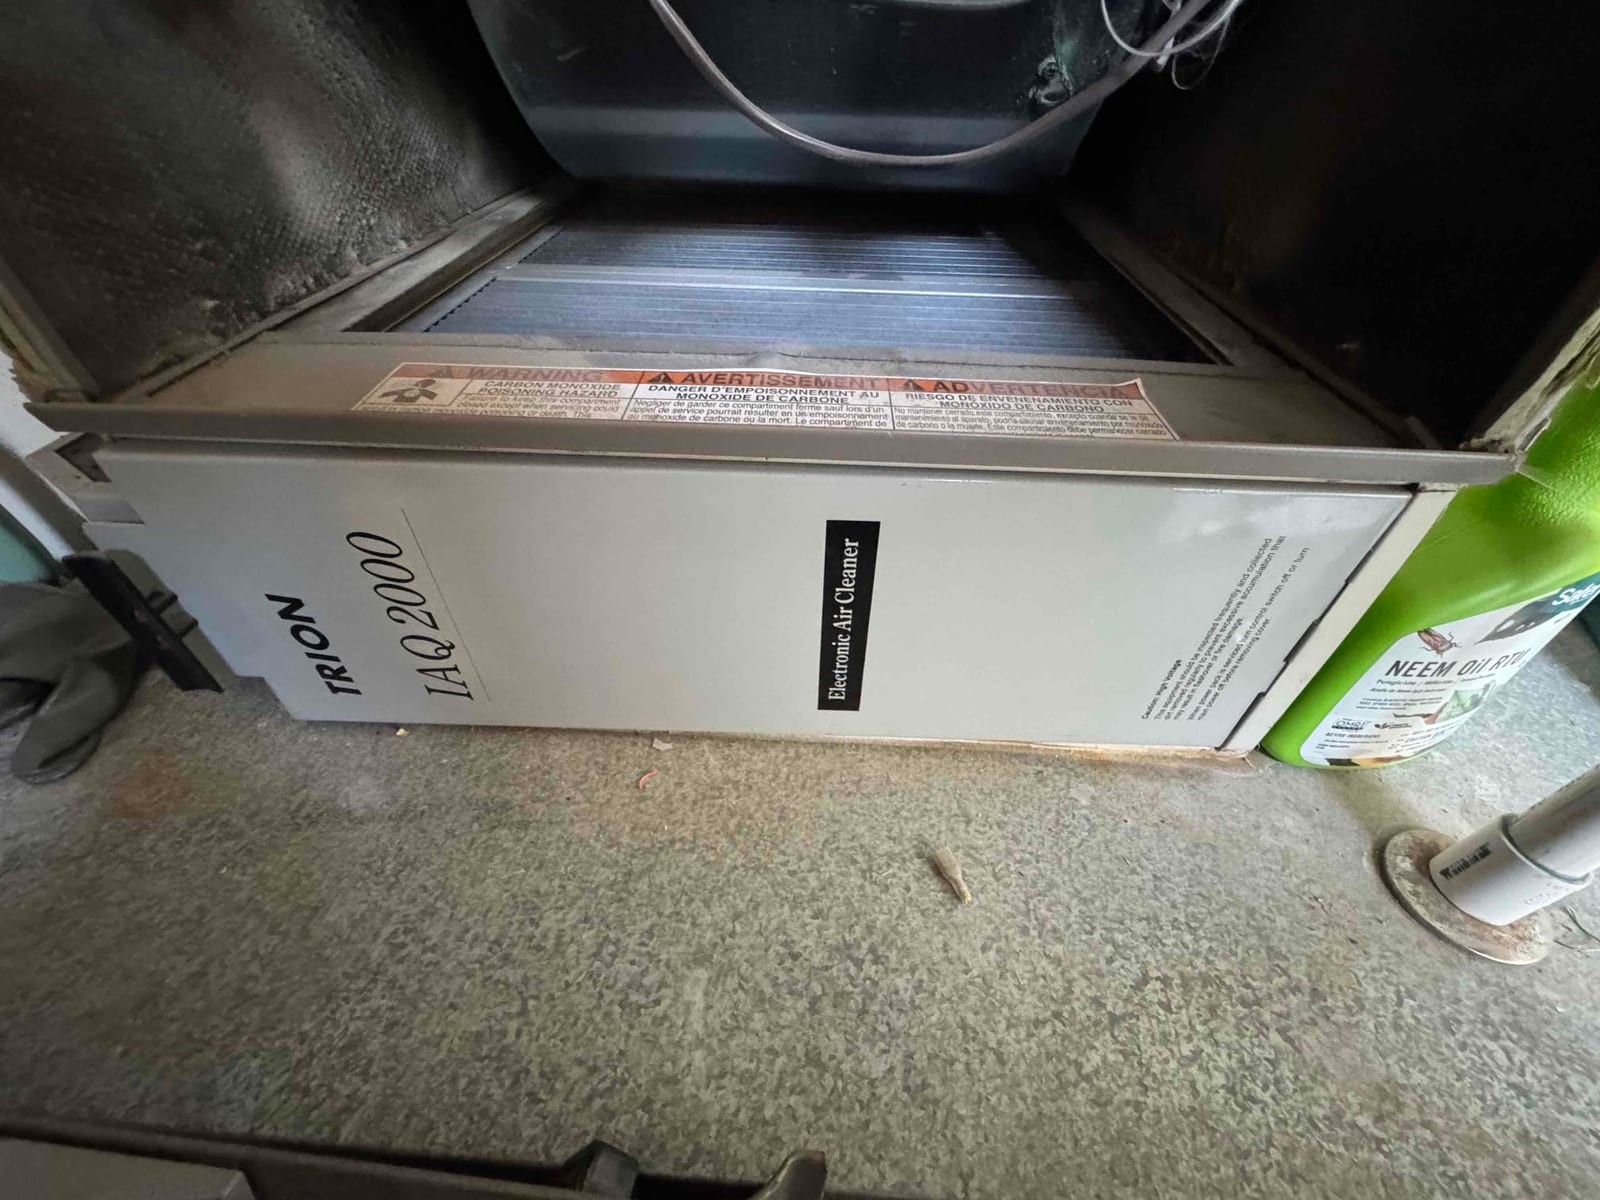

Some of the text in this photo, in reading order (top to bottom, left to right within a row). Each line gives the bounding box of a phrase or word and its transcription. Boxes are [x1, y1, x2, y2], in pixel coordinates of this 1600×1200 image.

[471, 368, 603, 382] WARNING
[681, 372, 879, 389] AVERTISSEMENT
[478, 387, 619, 398] POISONING HAZARD
[485, 381, 621, 391] CARBON MONOXIDE
[648, 385, 707, 393] DANGER
[711, 386, 855, 397] D'EMPOISONNEMENT
[933, 380, 1128, 398] ADVERTENCIA
[559, 397, 620, 406] compartment
[676, 392, 850, 404] MONOXIDE DE CARBONE
[905, 393, 955, 401] RIESGO
[979, 395, 1101, 405] ENVENENAMIENTO
[687, 401, 717, 409] garder
[732, 402, 793, 410] compartiment
[824, 404, 843, 412] sauf
[1015, 402, 1034, 410] DE
[1037, 404, 1105, 413] CARBONO
[706, 408, 742, 416] pourrait
[809, 411, 888, 420] empoisonnement
[703, 415, 741, 423] carbone
[809, 418, 873, 427] compartiment
[875, 420, 888, 428] de
[1196, 622, 1219, 652] inspected
[1214, 589, 1241, 622] frequently
[1237, 574, 1250, 586] and
[1245, 538, 1272, 571] collected
[1249, 607, 1268, 629] control
[1264, 585, 1283, 606] switch
[1279, 573, 1292, 583] off
[1288, 564, 1298, 572] or
[1293, 547, 1309, 563] turn
[1204, 633, 1223, 656] prevent
[1219, 601, 1243, 632] excessive
[1240, 553, 1275, 599] accumulation
[1270, 535, 1286, 551] that
[346, 531, 474, 701] IAQ 2000
[828, 537, 859, 701] Electronic Air Cleaner
[265, 593, 362, 695] TRION
[1235, 636, 1259, 664] removing
[1385, 659, 1458, 678] NEEM
[1457, 657, 1492, 676] Oil
